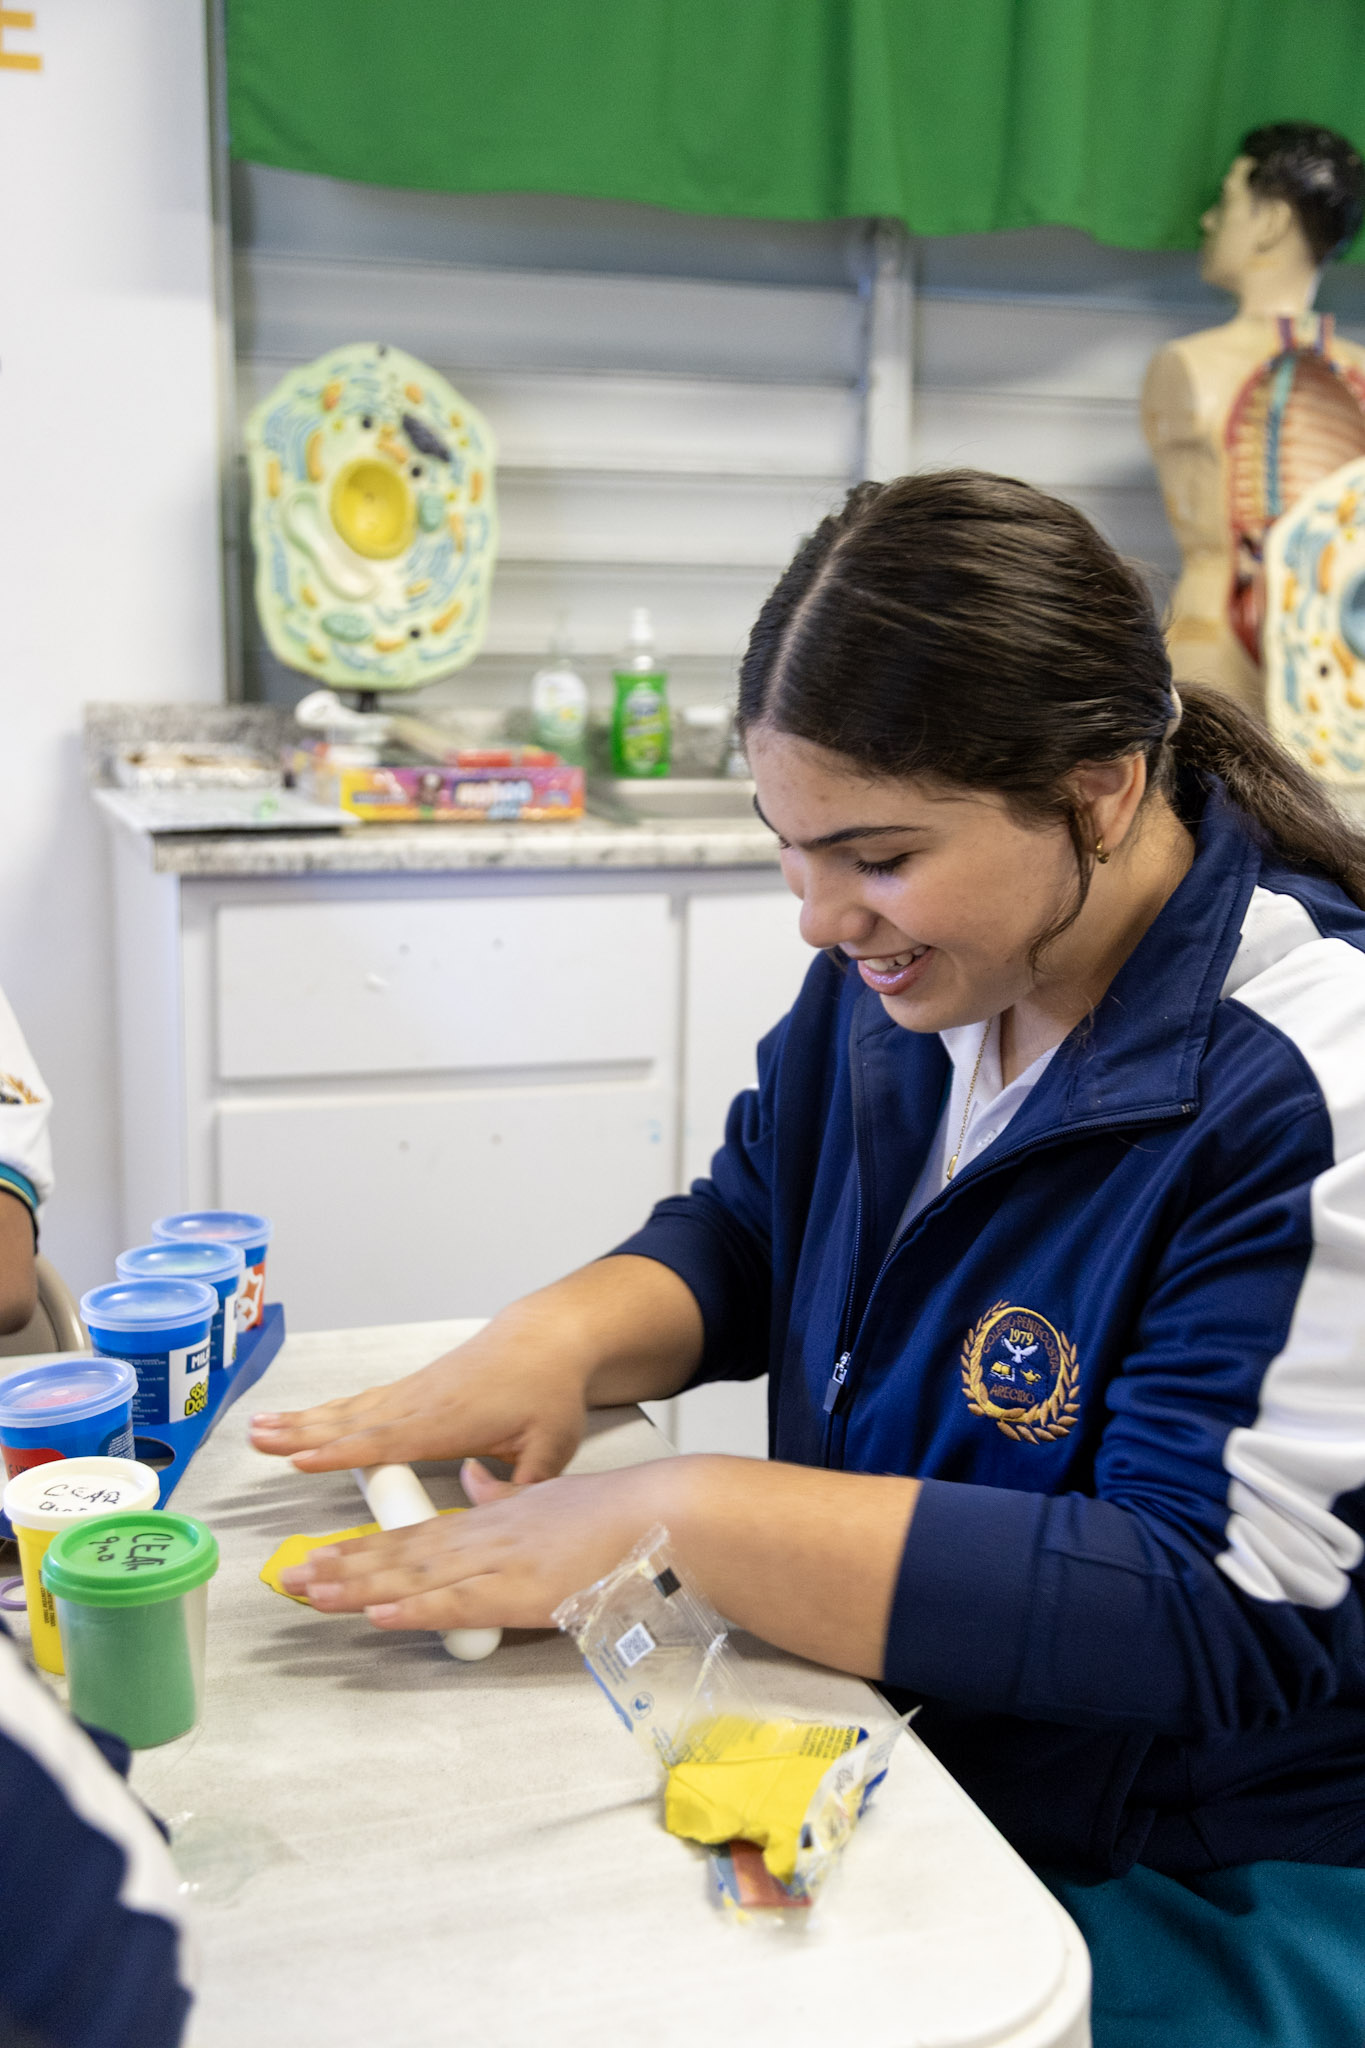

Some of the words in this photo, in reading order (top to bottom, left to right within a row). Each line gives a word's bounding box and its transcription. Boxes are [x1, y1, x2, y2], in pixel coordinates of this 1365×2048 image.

[982, 1315, 1016, 1354] COLEGIO
[1016, 1315, 1060, 1376] PENTECOSTAL
[1009, 1327, 1035, 1346] 1979
[990, 1384, 1035, 1404] ARECIBO
